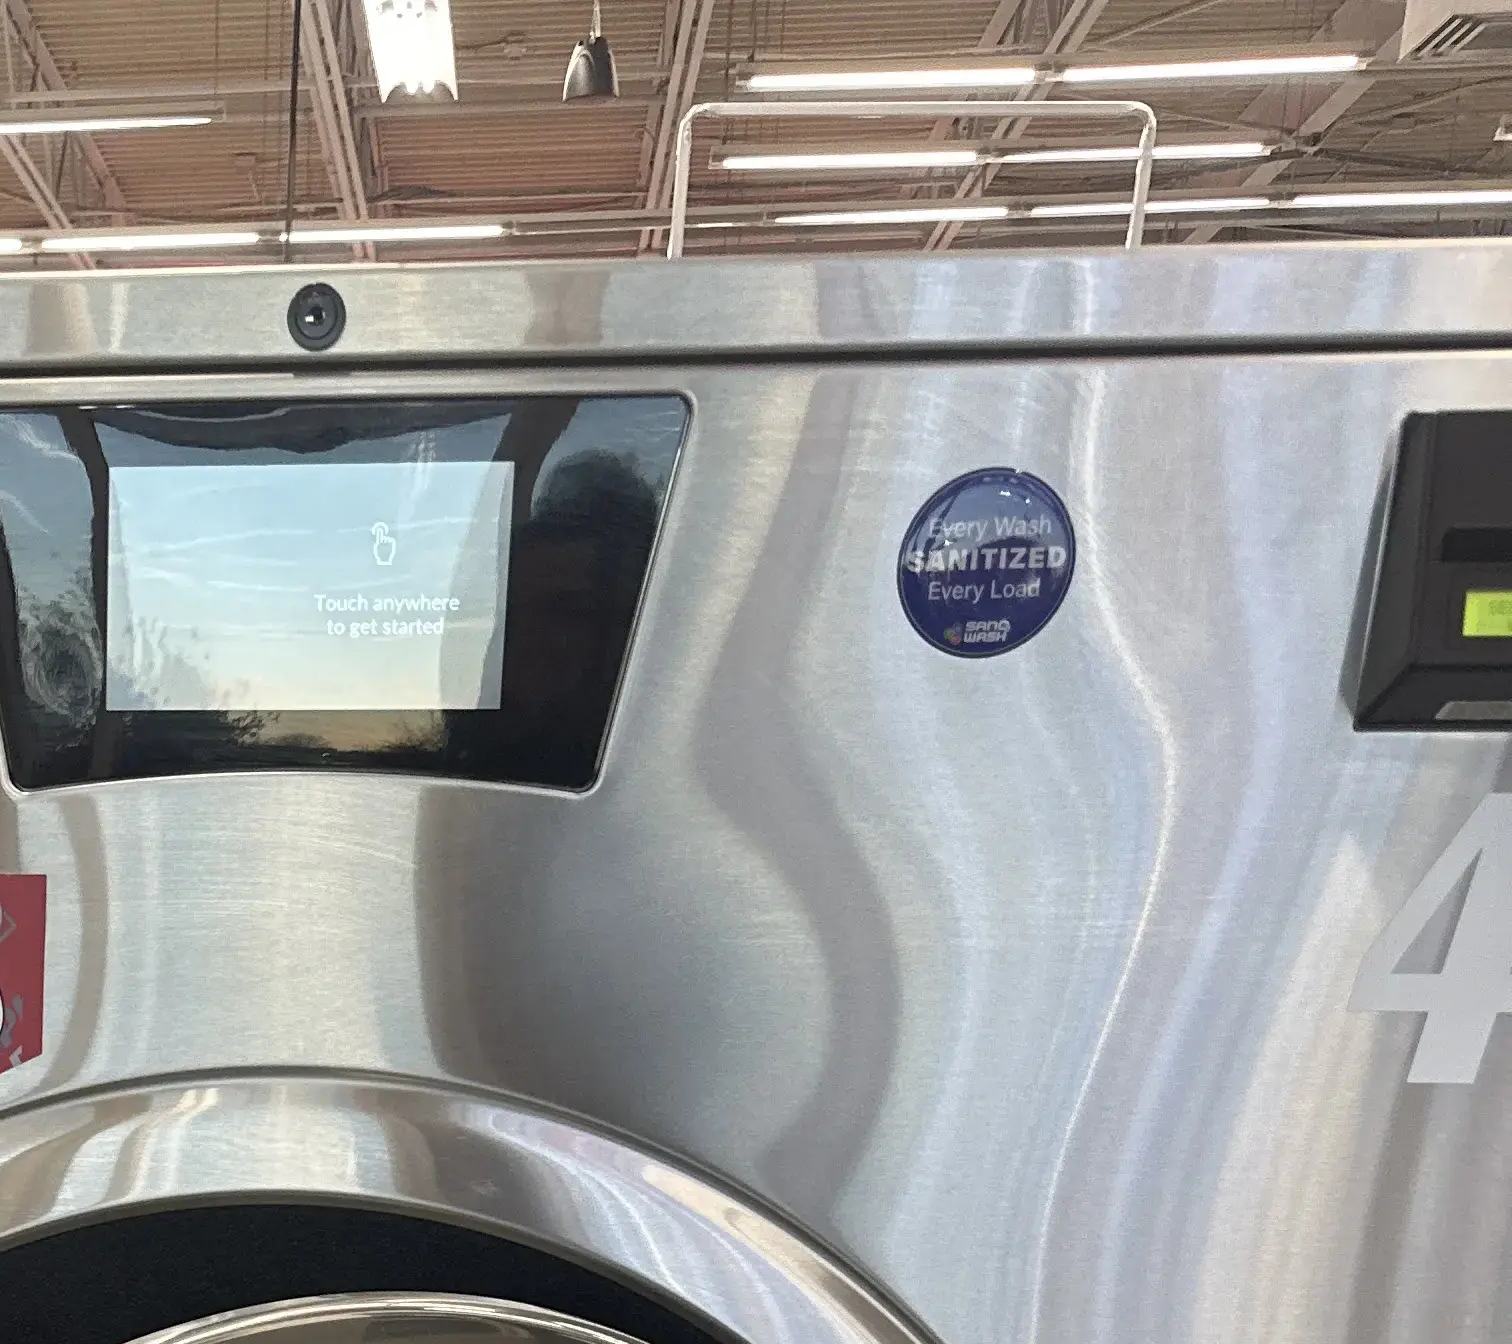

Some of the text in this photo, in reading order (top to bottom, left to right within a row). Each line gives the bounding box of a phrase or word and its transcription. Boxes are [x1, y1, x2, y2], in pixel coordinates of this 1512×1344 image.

[929, 514, 1051, 542] Every Wash
[906, 546, 1067, 573] SANITIZED
[313, 592, 461, 615] Touch anywhere
[928, 577, 1041, 604] Every Load
[326, 617, 445, 639] to get started
[1347, 792, 1512, 1084] 4
